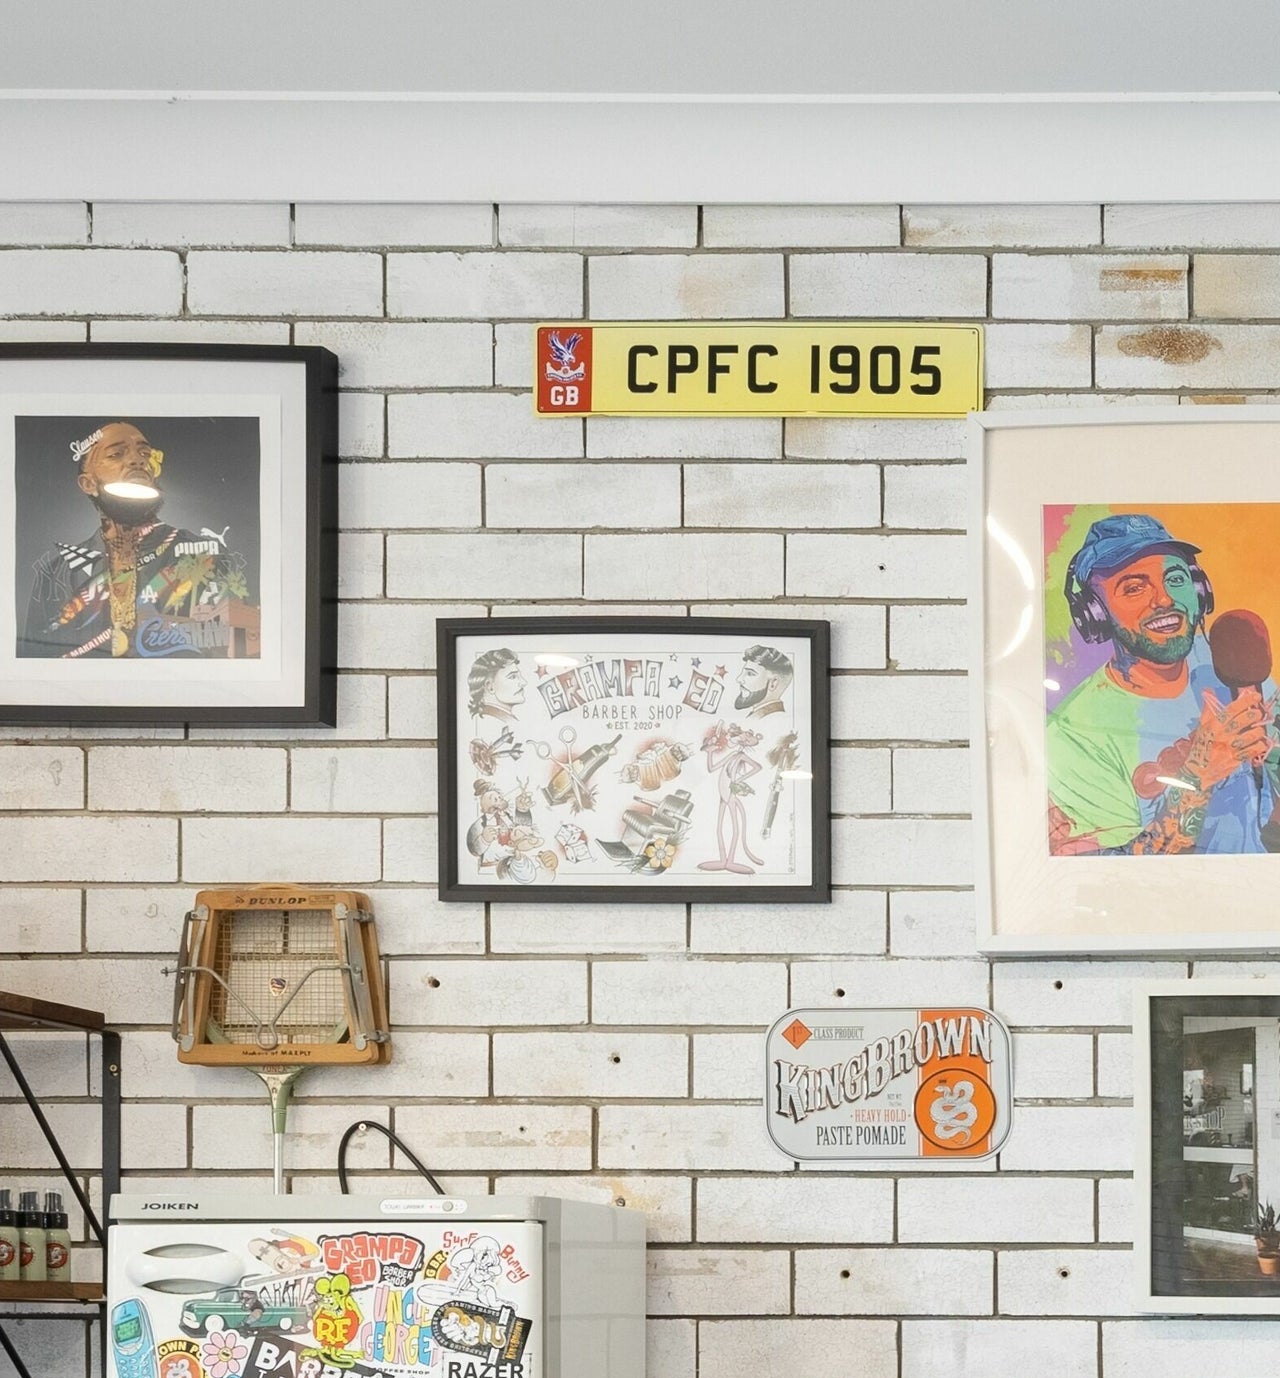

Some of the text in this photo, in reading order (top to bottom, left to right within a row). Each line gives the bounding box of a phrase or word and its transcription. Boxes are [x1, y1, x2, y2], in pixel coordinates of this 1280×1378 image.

[627, 344, 942, 396] CPFC 1905
[549, 385, 580, 406] GB
[536, 658, 726, 720] GRAMPA ED
[582, 704, 684, 720] BARBER SHOP
[633, 721, 653, 731] 2020
[248, 897, 307, 905] DUNLOP
[854, 1108, 907, 1123] HEAVY HOLD
[816, 1125, 907, 1146] PASTE POMADE
[141, 1202, 199, 1210] JOIKEN
[373, 1284, 432, 1327] UNCLE
